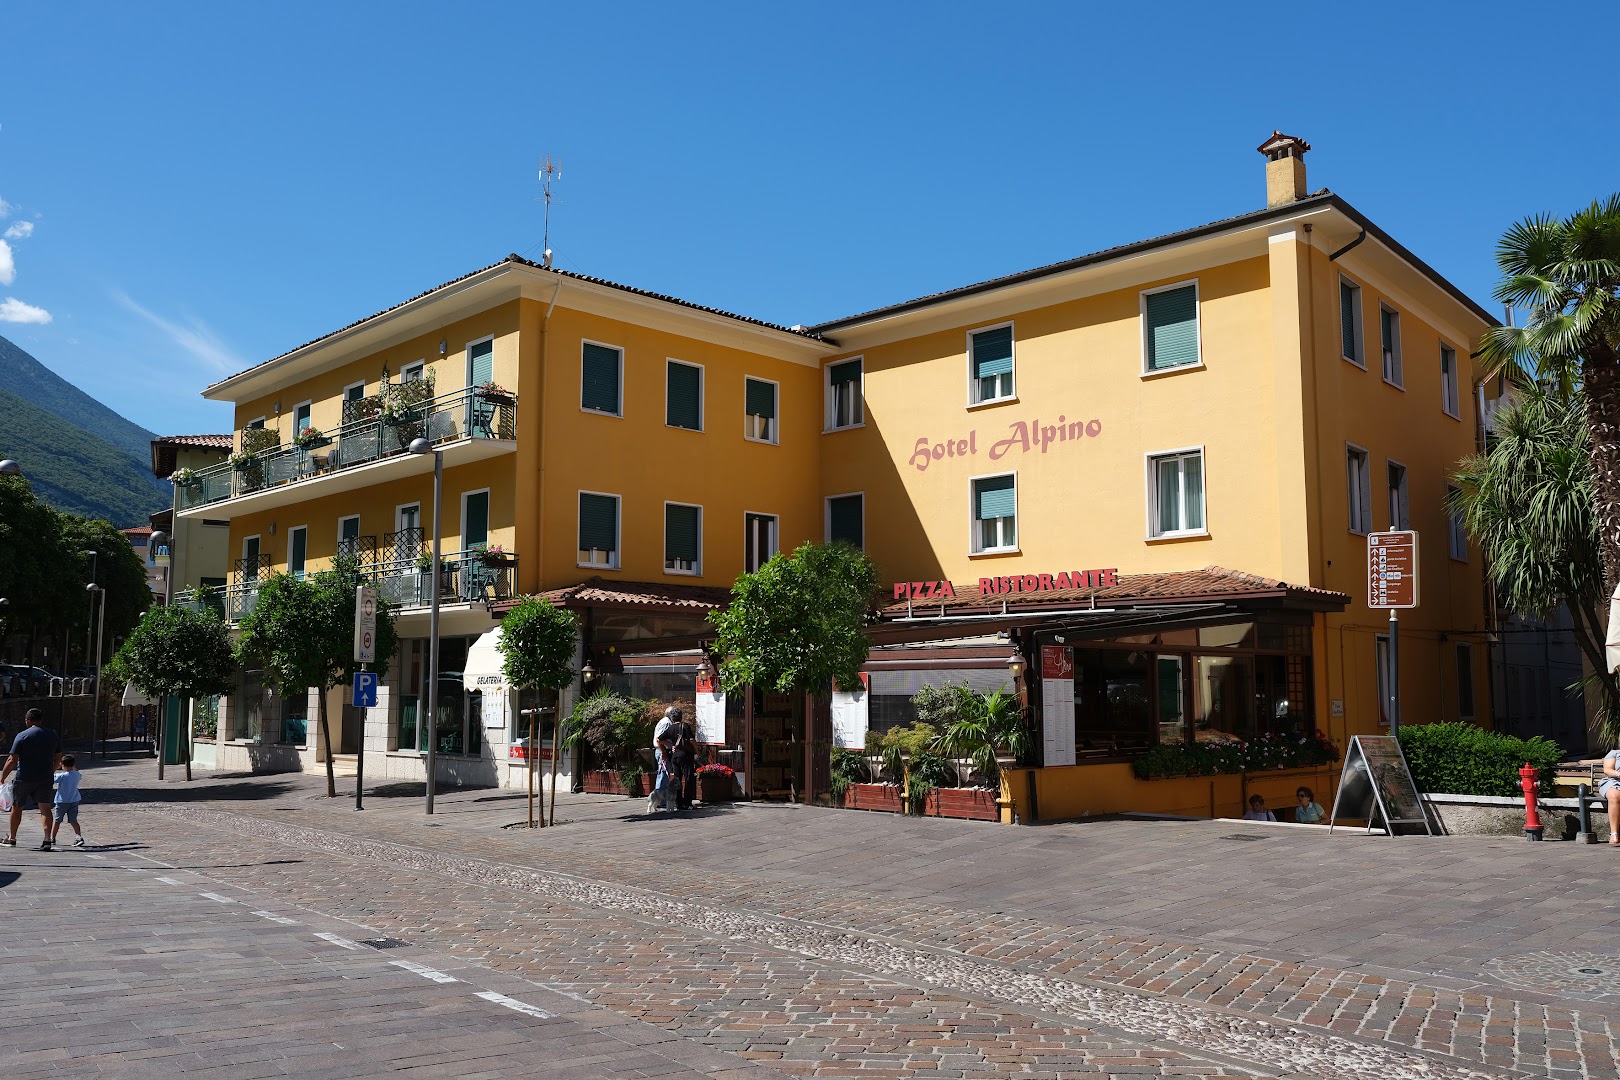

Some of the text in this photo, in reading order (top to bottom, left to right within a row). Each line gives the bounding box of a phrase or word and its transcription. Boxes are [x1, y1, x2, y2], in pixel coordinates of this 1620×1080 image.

[908, 415, 1102, 472] Hotel Alpino
[893, 568, 1119, 599] PIZZA RISTORANTE
[359, 675, 372, 691] P
[477, 676, 502, 685] GELATERIA
